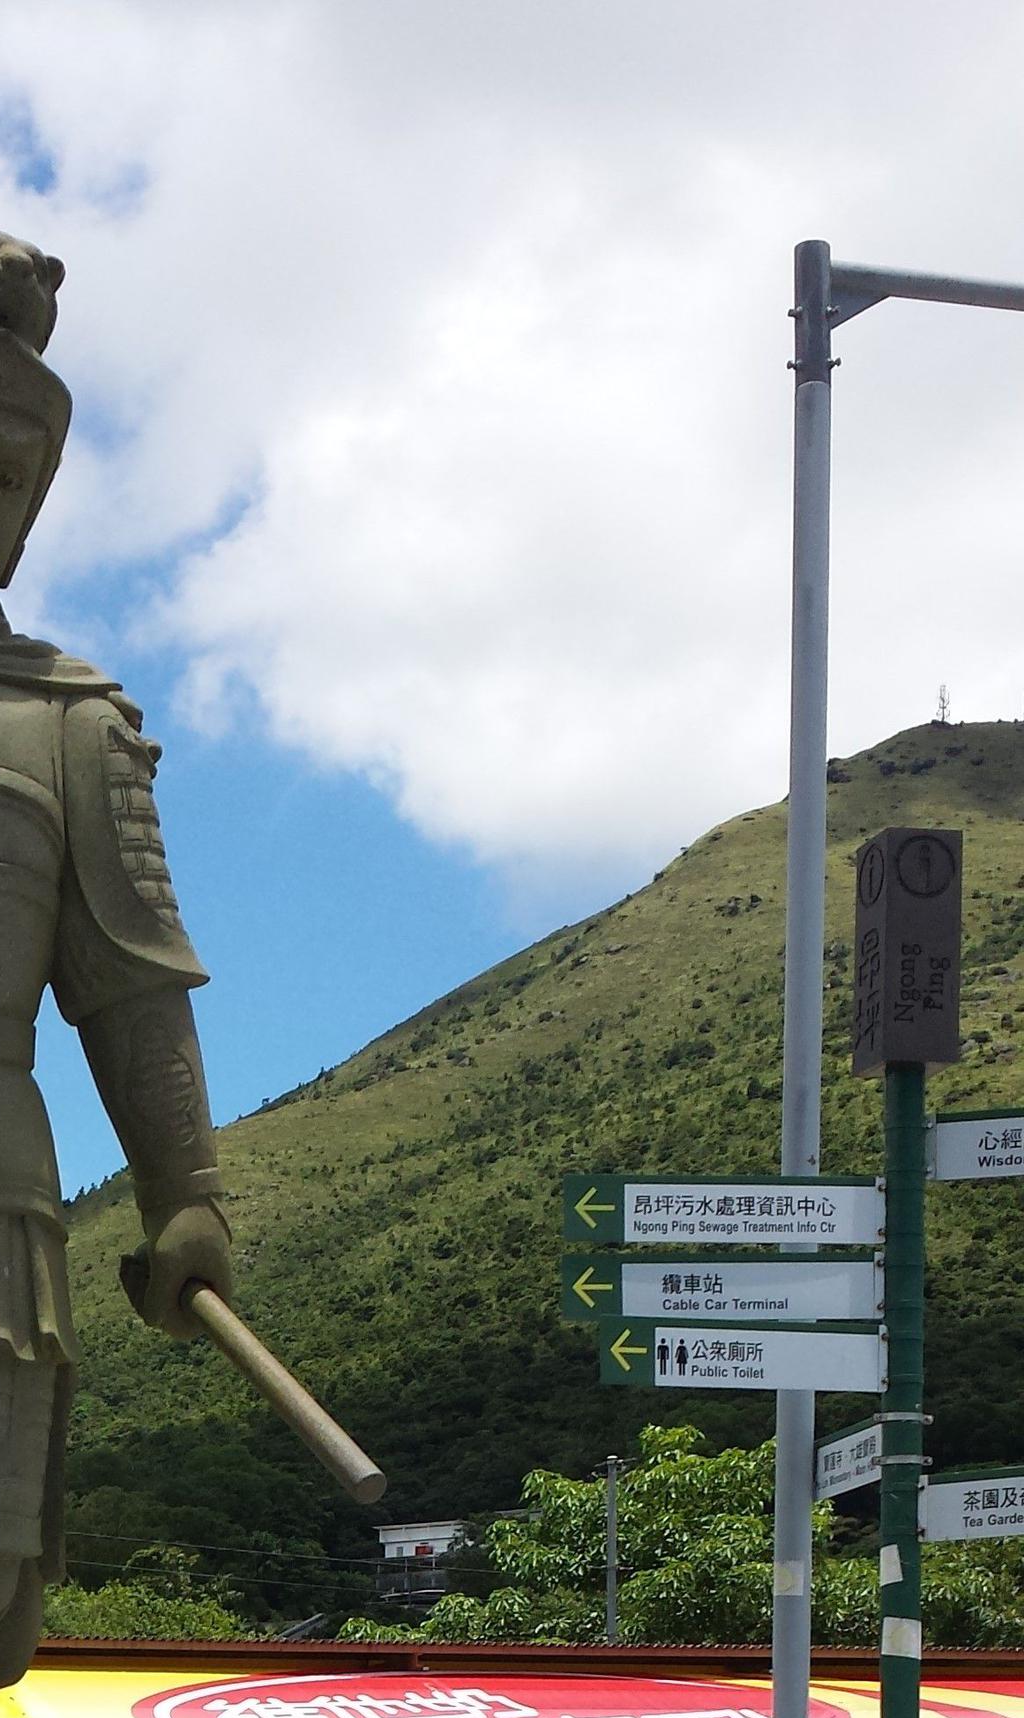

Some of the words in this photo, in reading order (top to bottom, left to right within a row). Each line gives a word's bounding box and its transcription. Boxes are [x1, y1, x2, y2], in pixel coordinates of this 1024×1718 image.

[894, 943, 922, 1023] Ngong
[923, 957, 951, 1012] Ping
[978, 1155, 1024, 1168] Wisdo
[633, 1195, 837, 1217] 昂坪污水處理資訊中心
[633, 1221, 668, 1234] Ngong
[671, 1221, 695, 1234] Ping
[699, 1221, 739, 1235] Sewage
[742, 1221, 794, 1233] Treatment
[797, 1221, 817, 1233] Info
[820, 1221, 837, 1233] Ctr
[661, 1273, 723, 1295] 纜車站
[662, 1298, 700, 1311] Cable
[704, 1299, 728, 1311] Car
[732, 1298, 789, 1310] Terminal
[691, 1365, 728, 1378] Public
[732, 1366, 764, 1379] Toilet
[963, 1487, 1024, 1511] 茶園及
[962, 1516, 984, 1528] Tea
[987, 1512, 1024, 1526] Garde
